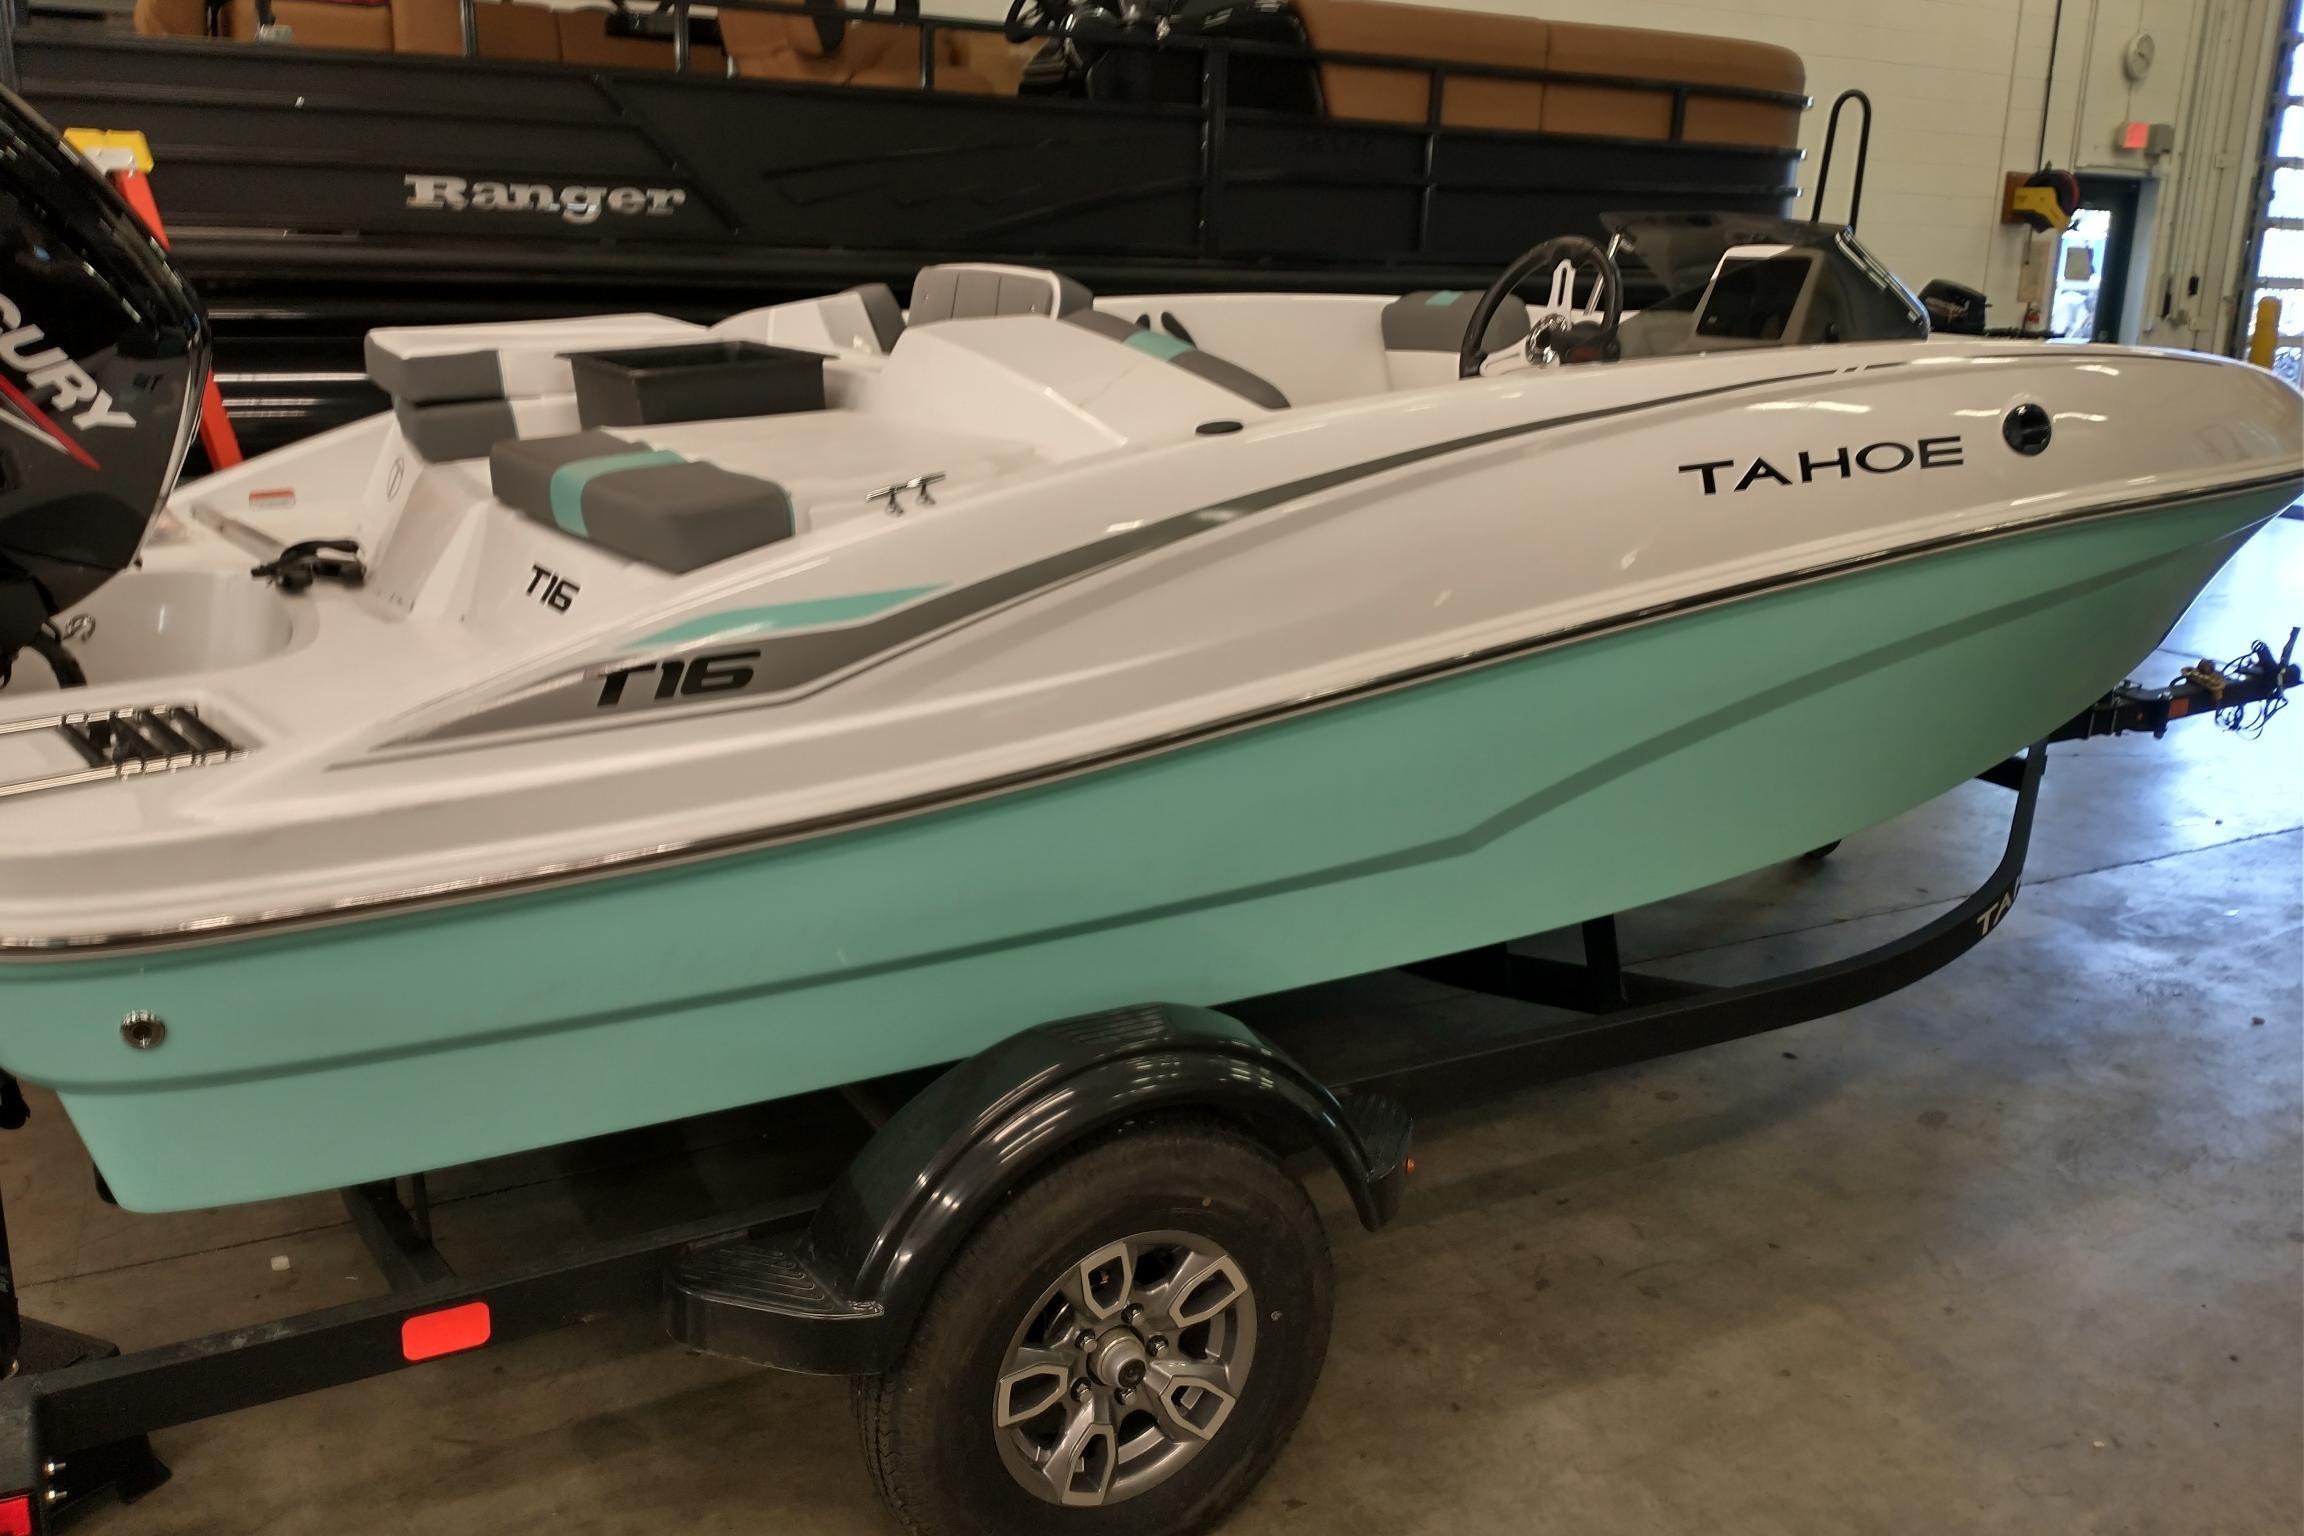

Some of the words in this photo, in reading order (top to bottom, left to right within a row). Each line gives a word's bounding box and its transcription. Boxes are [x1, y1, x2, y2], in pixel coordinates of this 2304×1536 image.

[403, 173, 687, 226] Ranger
[1678, 435, 1965, 496] TAHOE
[596, 649, 762, 709] T16
[1976, 874, 2022, 937] TA
